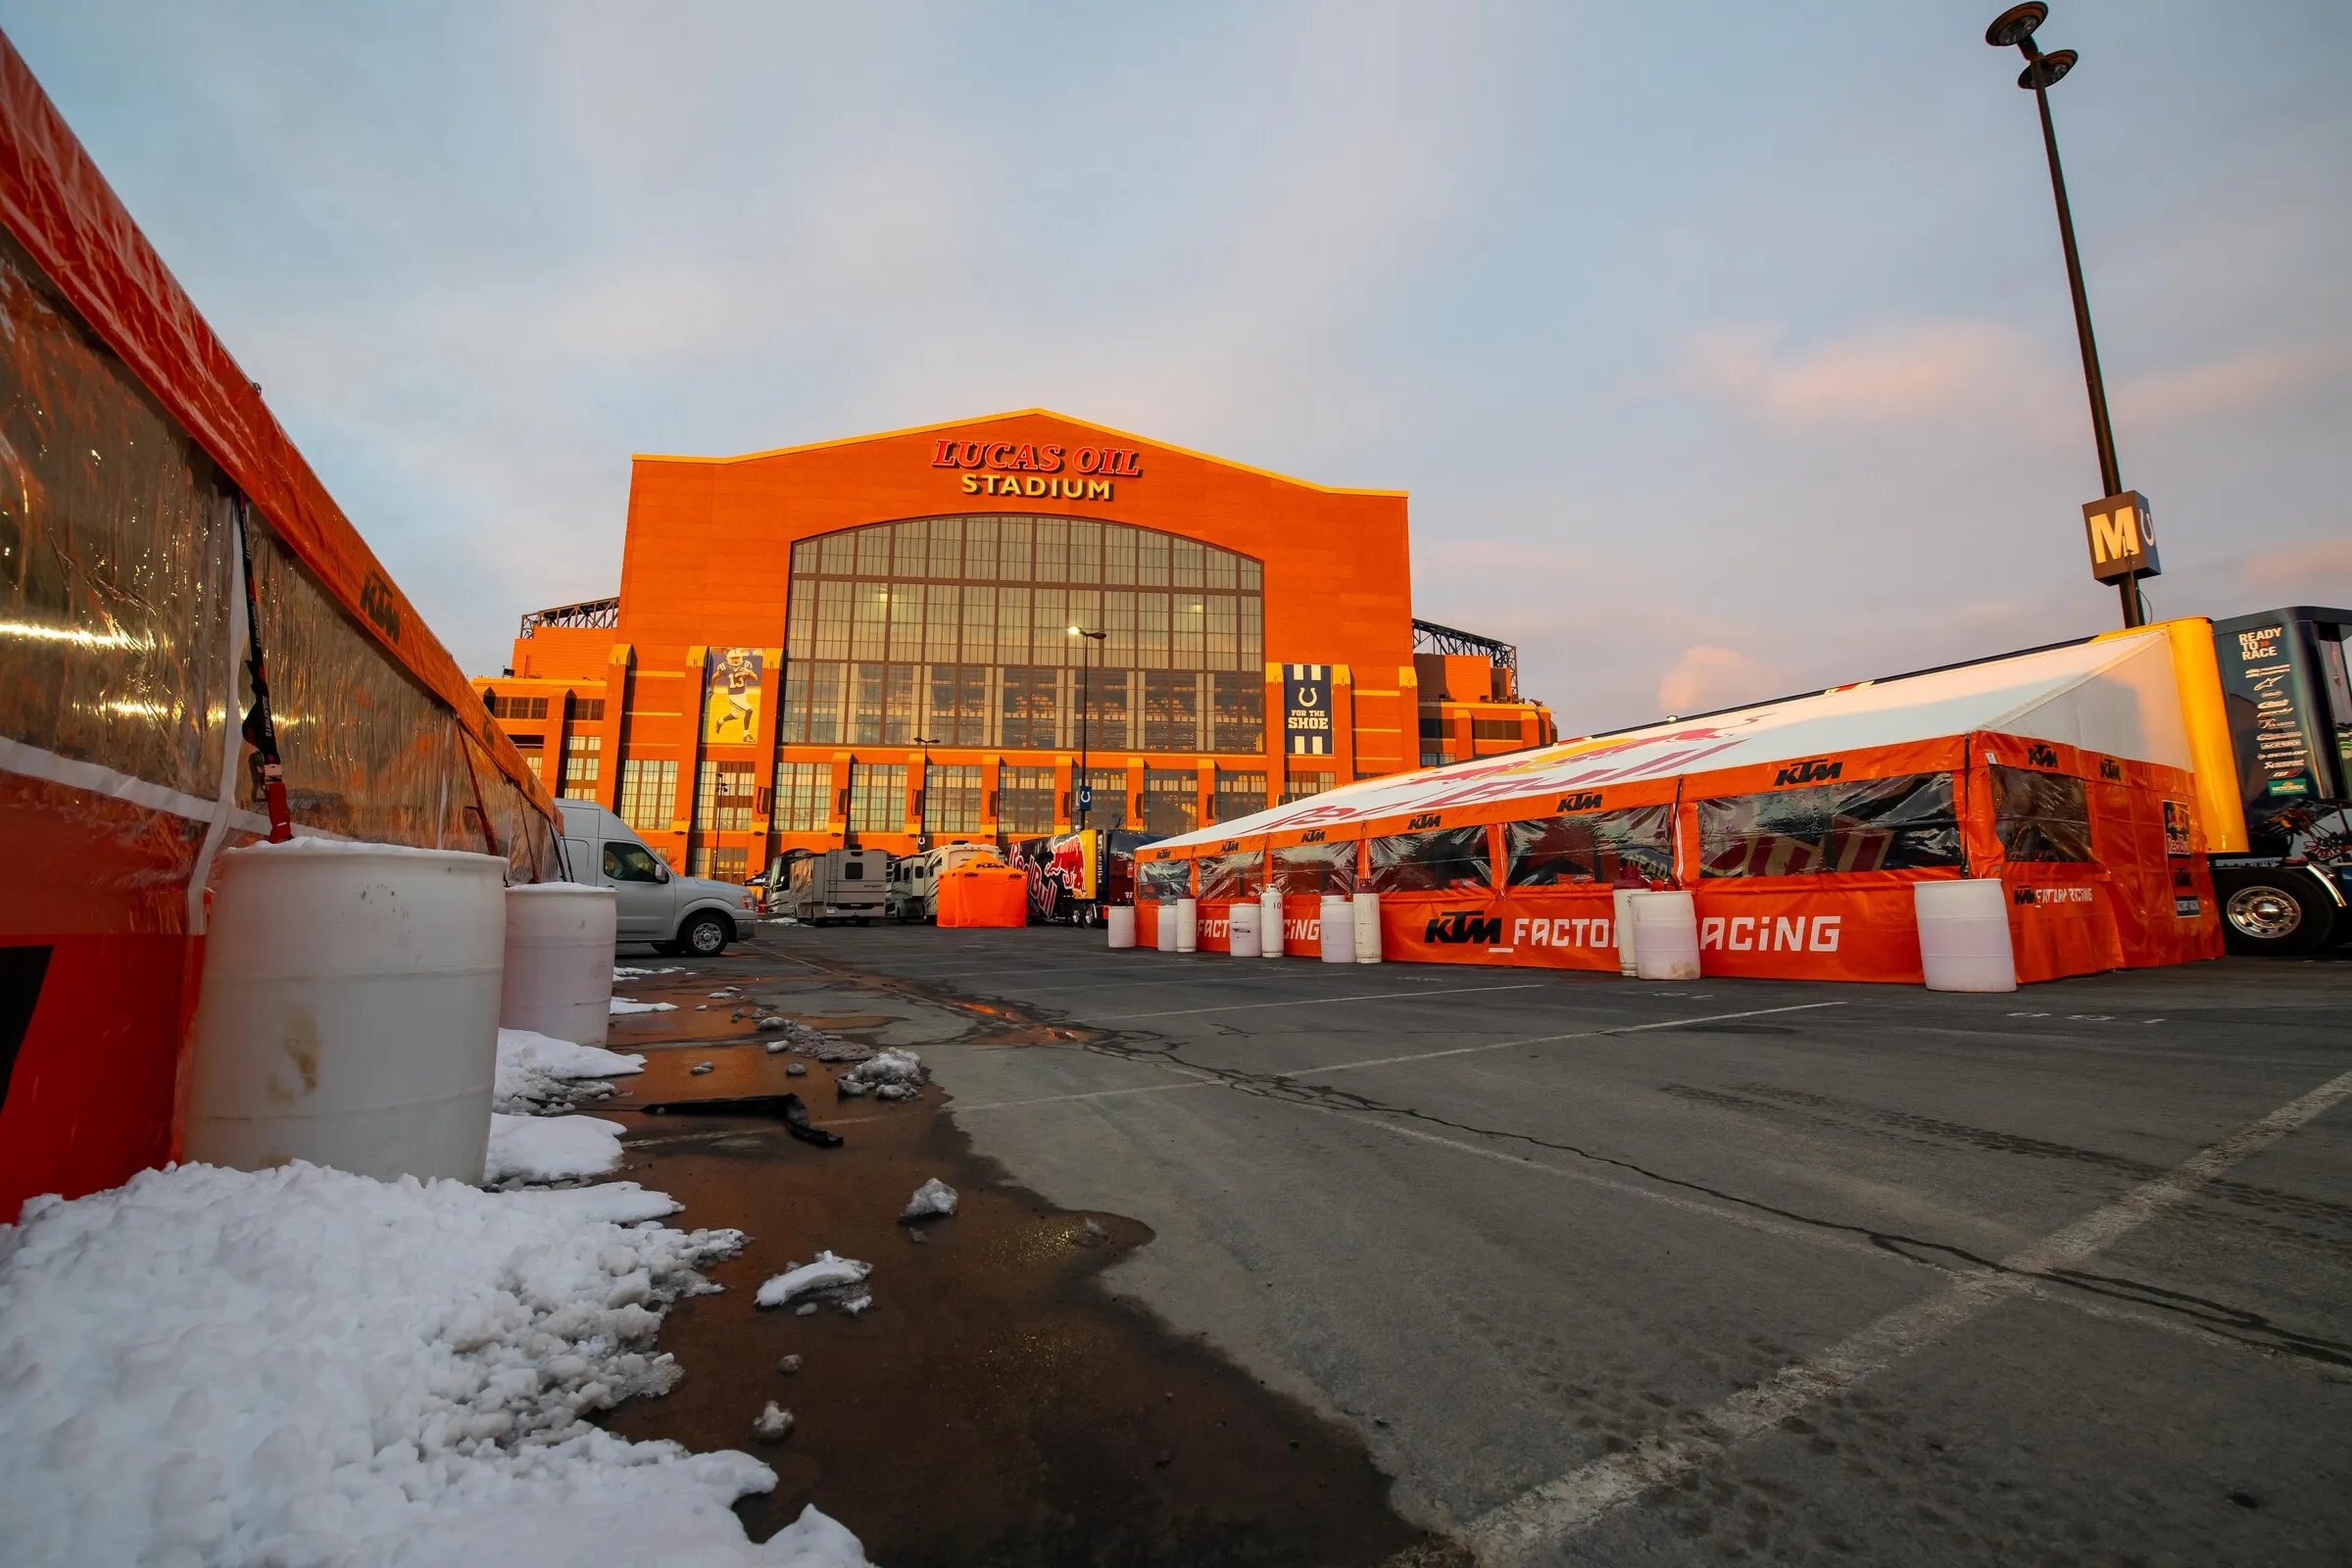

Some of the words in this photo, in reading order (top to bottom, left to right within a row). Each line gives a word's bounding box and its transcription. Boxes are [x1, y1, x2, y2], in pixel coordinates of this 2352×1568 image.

[932, 440, 1063, 471] LUCAS
[1072, 447, 1141, 476] OIL
[961, 474, 1111, 500] STADIUM
[2089, 507, 2140, 564] M
[2238, 627, 2282, 644] READY
[2240, 641, 2259, 652] TO
[2241, 646, 2278, 661] RACE
[728, 673, 745, 688] 13
[1288, 716, 1329, 730] SHOE
[2028, 744, 2059, 768] KTM
[1773, 759, 1843, 786] KTM
[2100, 759, 2122, 781] KTM
[1555, 792, 1603, 812] KTM
[1407, 812, 1443, 830] KTM
[1300, 828, 1326, 843] KTM
[1155, 849, 1171, 860] KTM
[1221, 840, 1240, 853] KTM
[1028, 861, 1058, 918] Bull
[1197, 919, 1230, 938] FACT
[1424, 910, 1502, 944] KTM
[1513, 918, 1618, 949] FACTO
